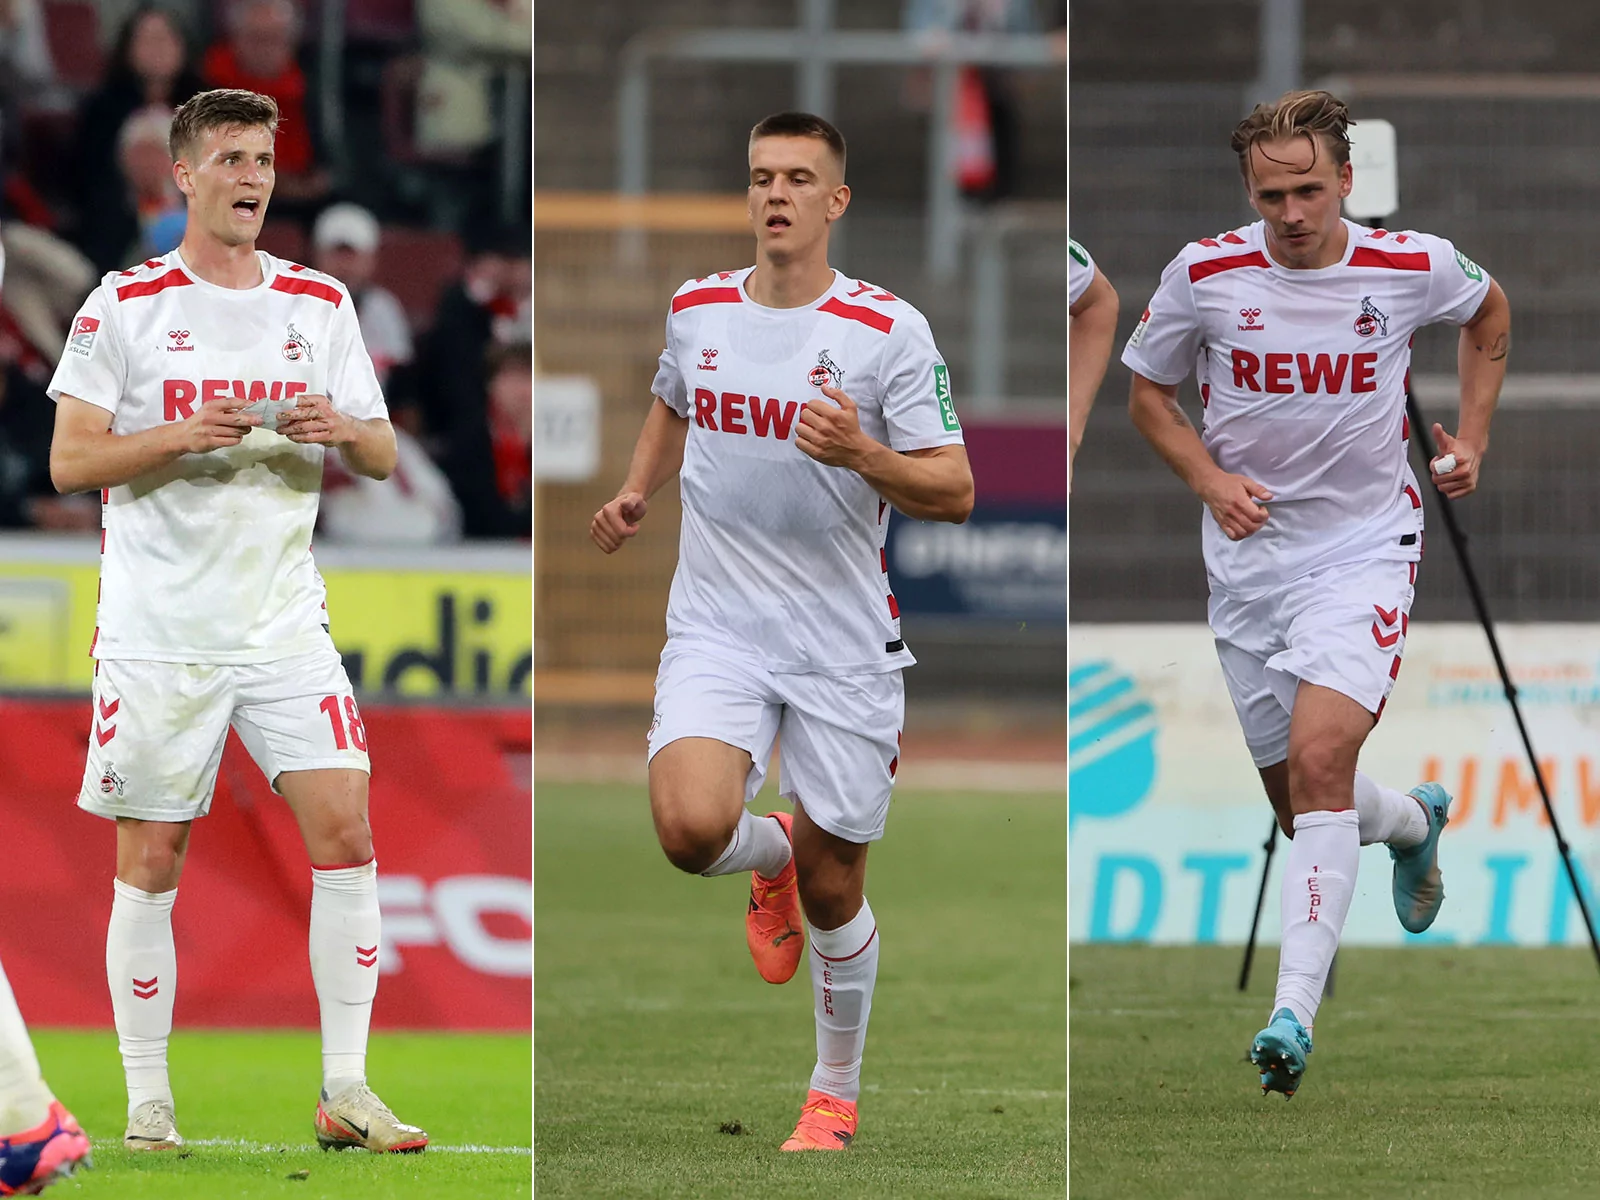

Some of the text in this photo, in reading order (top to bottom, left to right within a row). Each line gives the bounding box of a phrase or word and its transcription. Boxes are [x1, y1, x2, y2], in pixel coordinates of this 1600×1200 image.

[166, 344, 194, 352] hummel
[1237, 323, 1265, 332] hummel
[696, 363, 718, 371] hummel
[1231, 349, 1379, 395] REWE
[694, 387, 808, 441] REW
[937, 371, 957, 425] DEVK
[319, 695, 367, 752] 18
